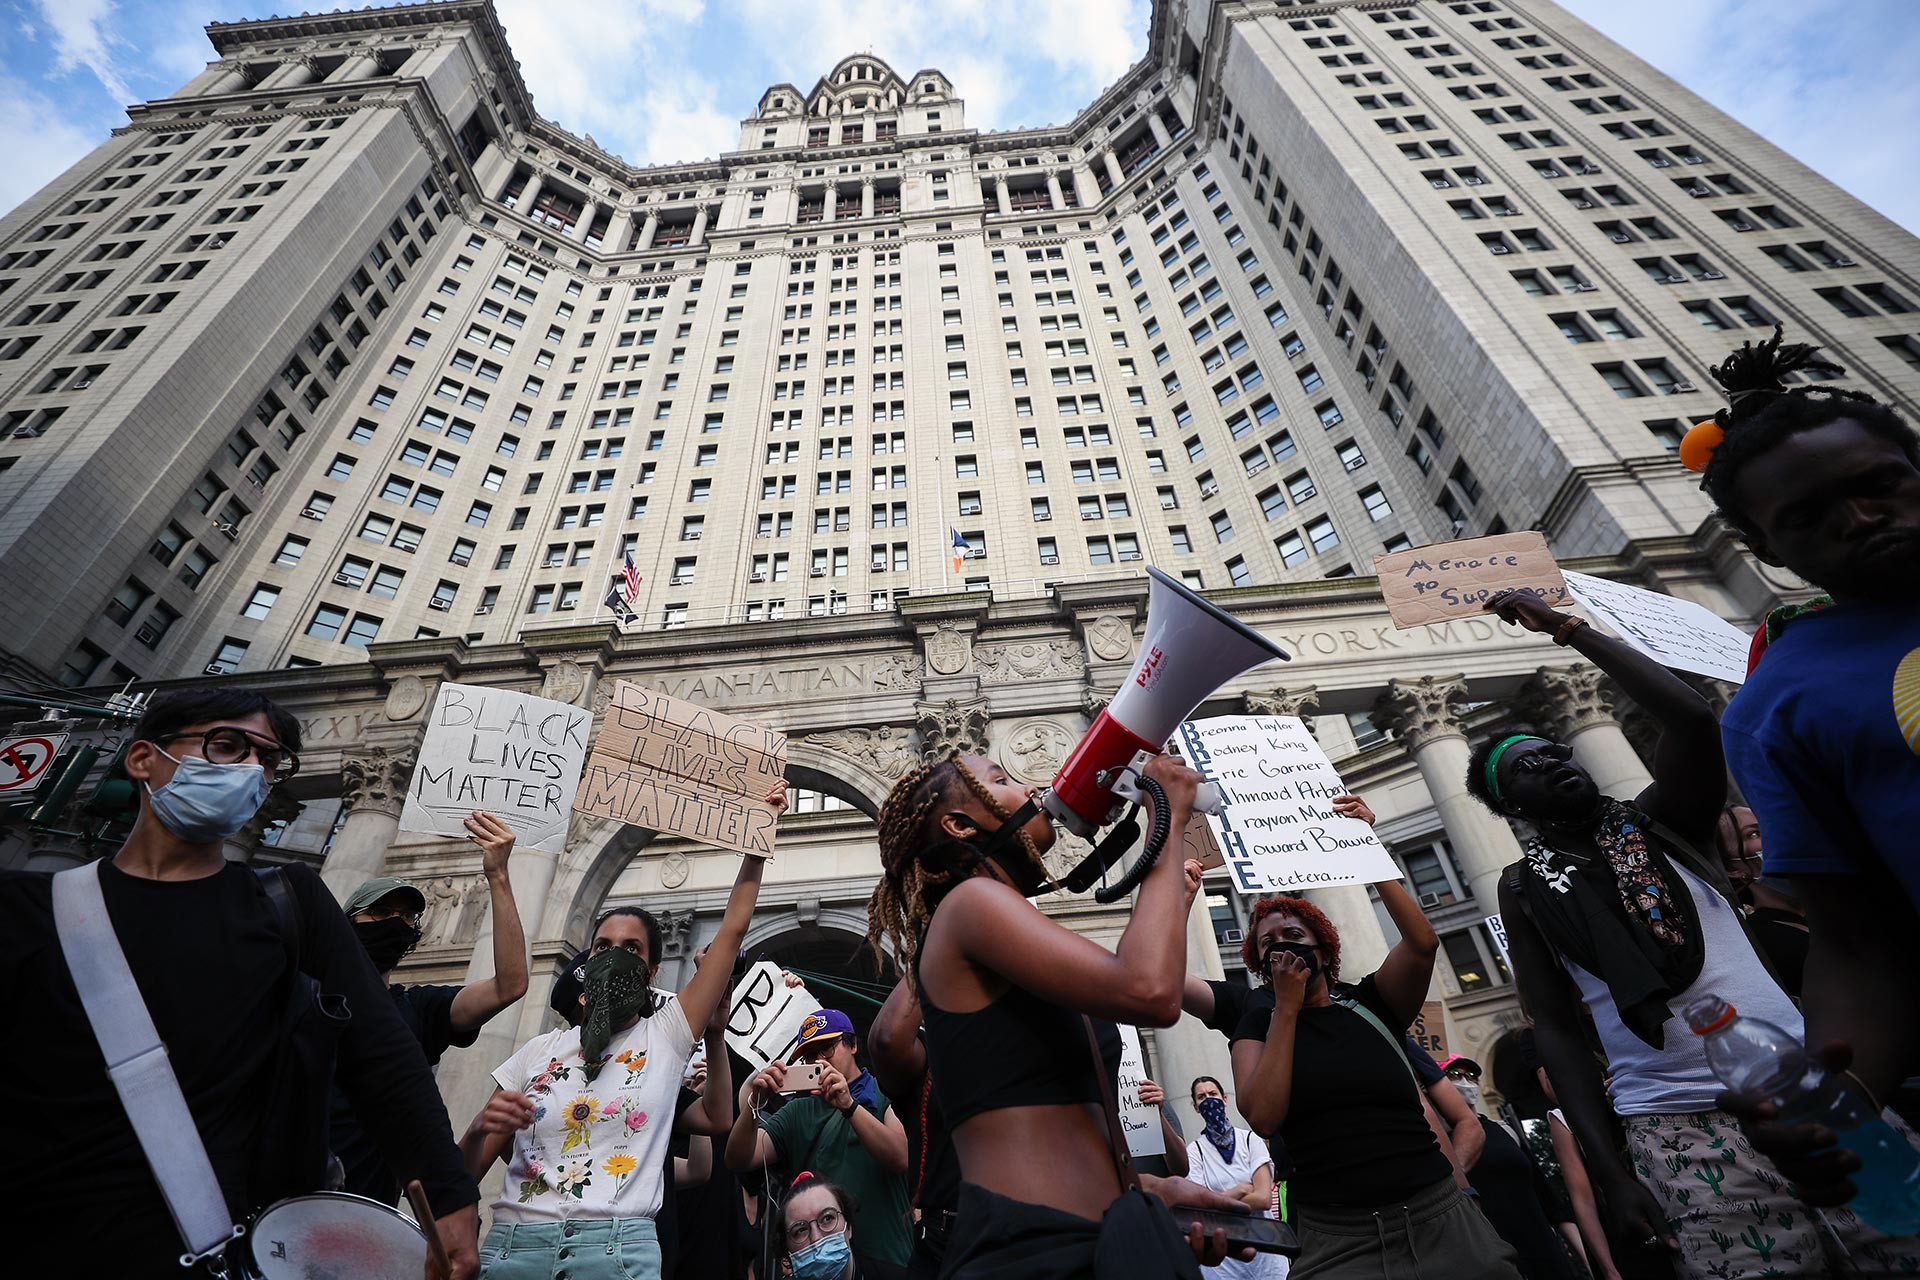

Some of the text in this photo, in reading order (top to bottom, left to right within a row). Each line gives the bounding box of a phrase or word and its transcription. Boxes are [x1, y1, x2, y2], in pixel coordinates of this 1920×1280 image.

[1405, 553, 1518, 577] Menace
[1413, 580, 1439, 595] to
[1281, 627, 1402, 657] YORK
[658, 663, 866, 700] MANHATTAN
[1136, 646, 1163, 688] PYLE
[439, 688, 586, 750] BLACK
[618, 686, 787, 777] BLACK
[1179, 717, 1296, 744] Breonna Taylor
[468, 733, 568, 780] LIVES
[1186, 737, 1309, 762] Rodney King
[628, 736, 747, 802] LIVES
[1193, 758, 1326, 782] Eric Garner
[417, 764, 562, 816] MATTER
[587, 766, 775, 853] MATTER
[1221, 826, 1379, 858] Howard Bowie
